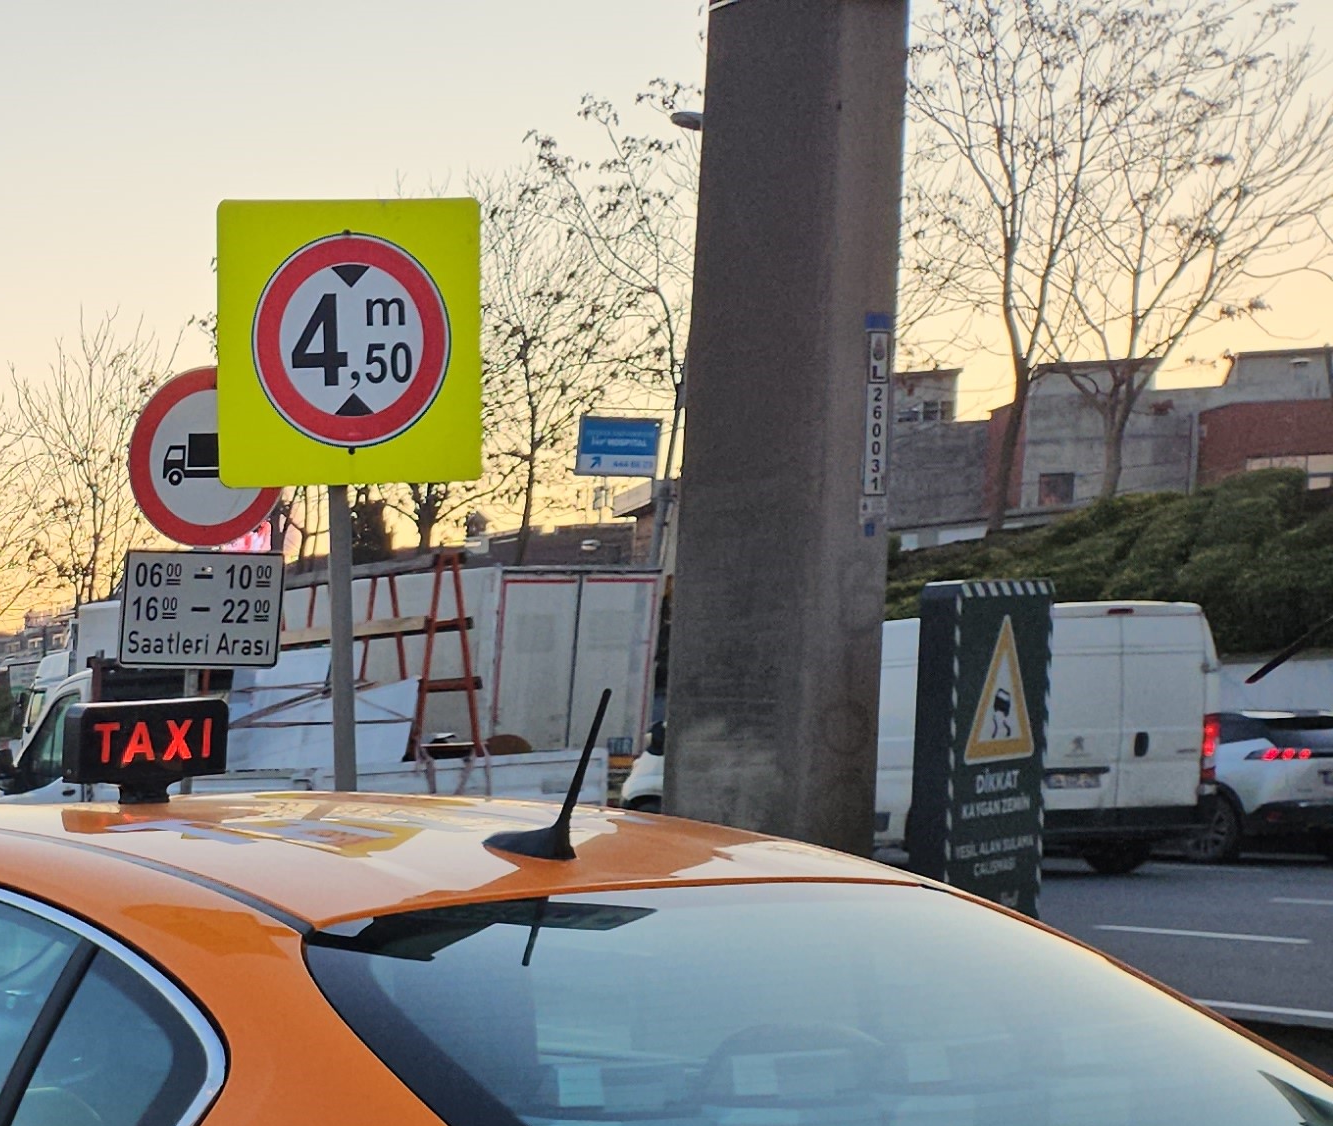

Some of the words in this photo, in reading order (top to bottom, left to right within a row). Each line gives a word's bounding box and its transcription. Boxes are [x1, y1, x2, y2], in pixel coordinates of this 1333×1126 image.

[871, 386, 883, 491] 260031
[216, 632, 270, 656] Arası
[92, 717, 214, 765] TAXI
[976, 767, 1020, 795] DİKKAT
